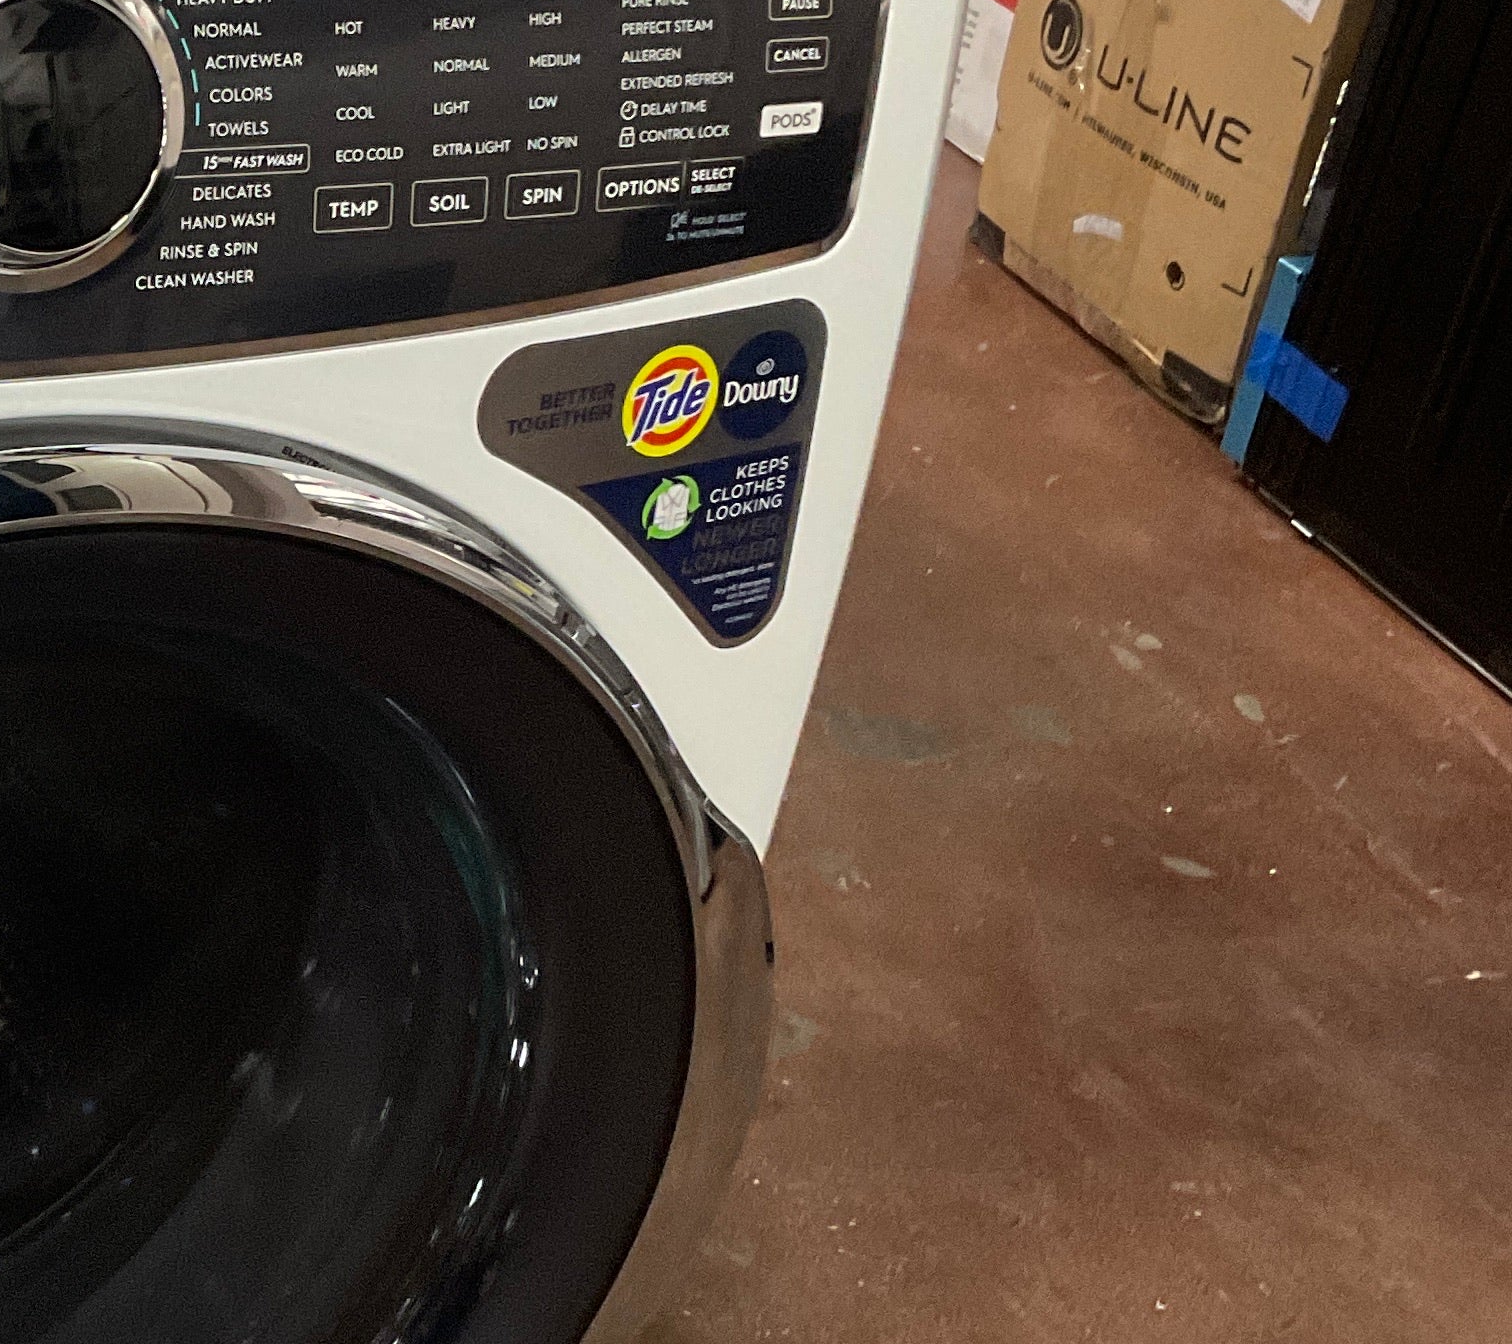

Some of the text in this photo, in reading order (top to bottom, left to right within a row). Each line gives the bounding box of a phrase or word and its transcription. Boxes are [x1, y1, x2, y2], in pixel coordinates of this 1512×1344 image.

[334, 20, 363, 35] HOT
[432, 16, 476, 31] HEAVY
[528, 12, 562, 26] HIGH
[621, 19, 713, 36] PERFECT STEAM
[193, 22, 262, 39] NORMAL
[204, 53, 303, 70] ACTIVEWEAR
[528, 53, 581, 68] MEDIUM
[621, 47, 681, 63] ALLERGEN
[773, 48, 822, 63] CANCEL
[335, 63, 378, 78] WARM
[433, 58, 490, 73] NORMAL
[621, 71, 734, 90] EXTENDED REFRESH
[209, 86, 273, 104] COLORS
[528, 96, 558, 111] LOW
[335, 106, 375, 121] COOL
[433, 100, 470, 116] LIGHT
[640, 100, 707, 117] DELAY TIME
[208, 121, 269, 137] TOWELS
[638, 125, 730, 144] CONTROL LOCK
[432, 139, 511, 157] EXTRA LIGHT
[526, 135, 578, 151] NO SPIN
[233, 155, 265, 169] FAST
[266, 153, 304, 167] WASH
[335, 147, 404, 163] ECO COLD
[691, 166, 736, 182] SELECT
[192, 183, 272, 201] DELICATES
[604, 176, 680, 199] OPTIONS
[428, 194, 470, 213] SOIL
[522, 187, 563, 206] SPIN
[1205, 190, 1227, 210] USA
[328, 200, 379, 219] TEMP
[180, 211, 276, 231] HAND WASH
[159, 241, 258, 260] RINSE & SPIN
[135, 269, 254, 290] CLEAN WASHER
[540, 381, 616, 411] BETTER
[723, 374, 799, 408] Downy
[626, 367, 711, 447] Tide
[507, 403, 613, 436] TOGETHER
[735, 455, 789, 479] KEEPS
[709, 474, 786, 504] CLOTHES
[705, 493, 783, 523] LOOKING
